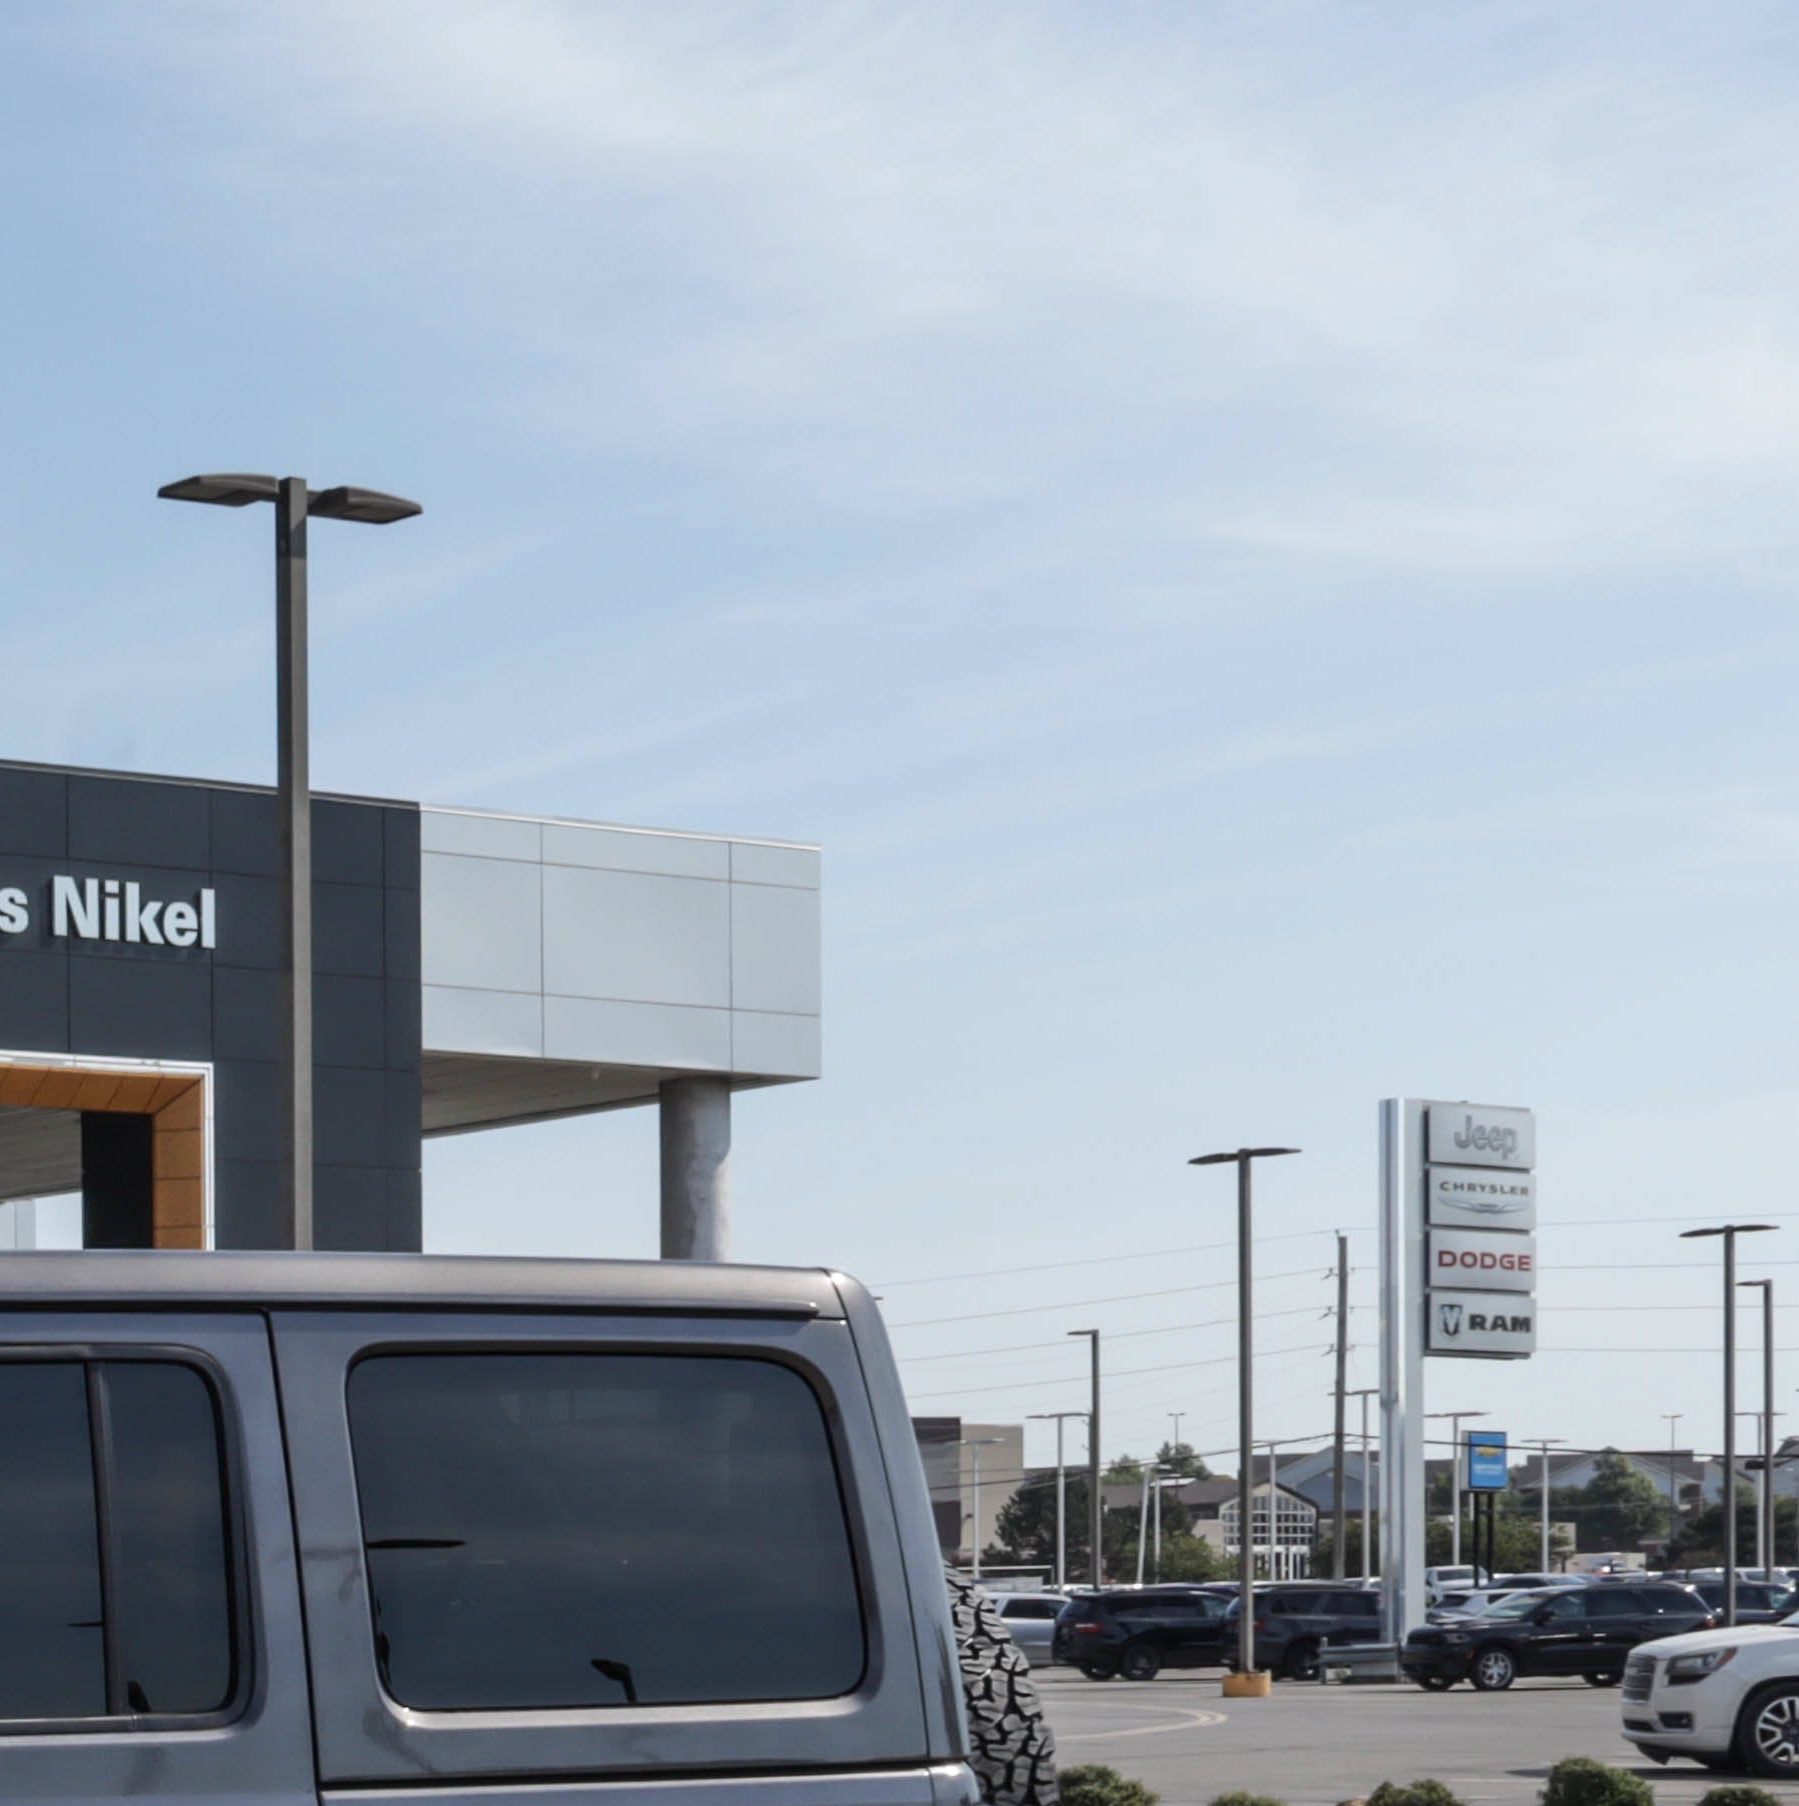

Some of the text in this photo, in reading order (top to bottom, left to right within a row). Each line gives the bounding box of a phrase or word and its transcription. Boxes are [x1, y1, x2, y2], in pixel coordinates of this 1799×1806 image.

[53, 874, 216, 949] Nikel
[1453, 1114, 1518, 1160] Jeep
[1439, 1180, 1529, 1197] CHRYSLER
[1437, 1250, 1531, 1272] DODGE
[1468, 1312, 1531, 1334] RAM
